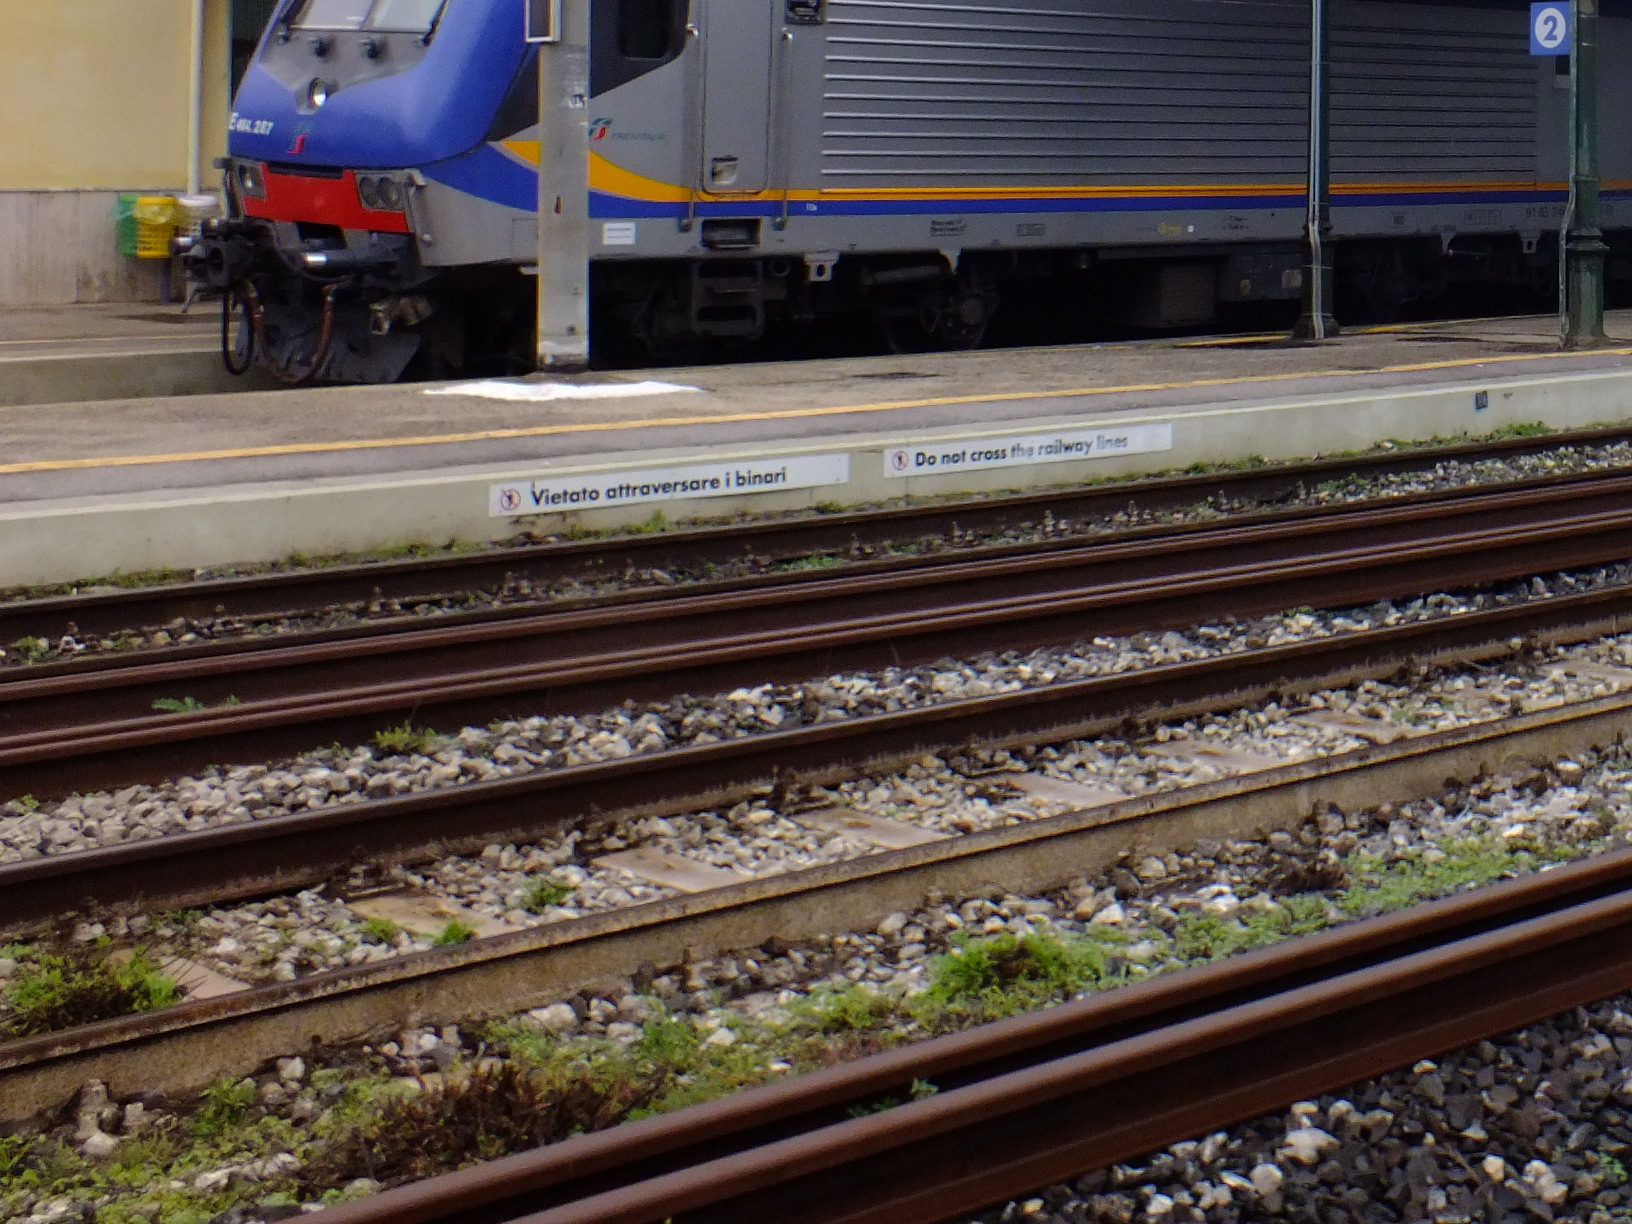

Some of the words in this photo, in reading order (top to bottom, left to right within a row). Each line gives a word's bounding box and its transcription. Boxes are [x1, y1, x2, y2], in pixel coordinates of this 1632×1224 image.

[1543, 15, 1558, 42] 2
[915, 451, 937, 468] Do
[941, 449, 967, 465] not
[970, 449, 1007, 463] cross
[1010, 443, 1034, 459] the
[1037, 439, 1093, 457] railway
[1096, 434, 1129, 450] lines
[530, 483, 601, 507] Vietato
[604, 476, 721, 501] attraversare
[725, 471, 732, 488] i
[735, 466, 787, 487] binari
